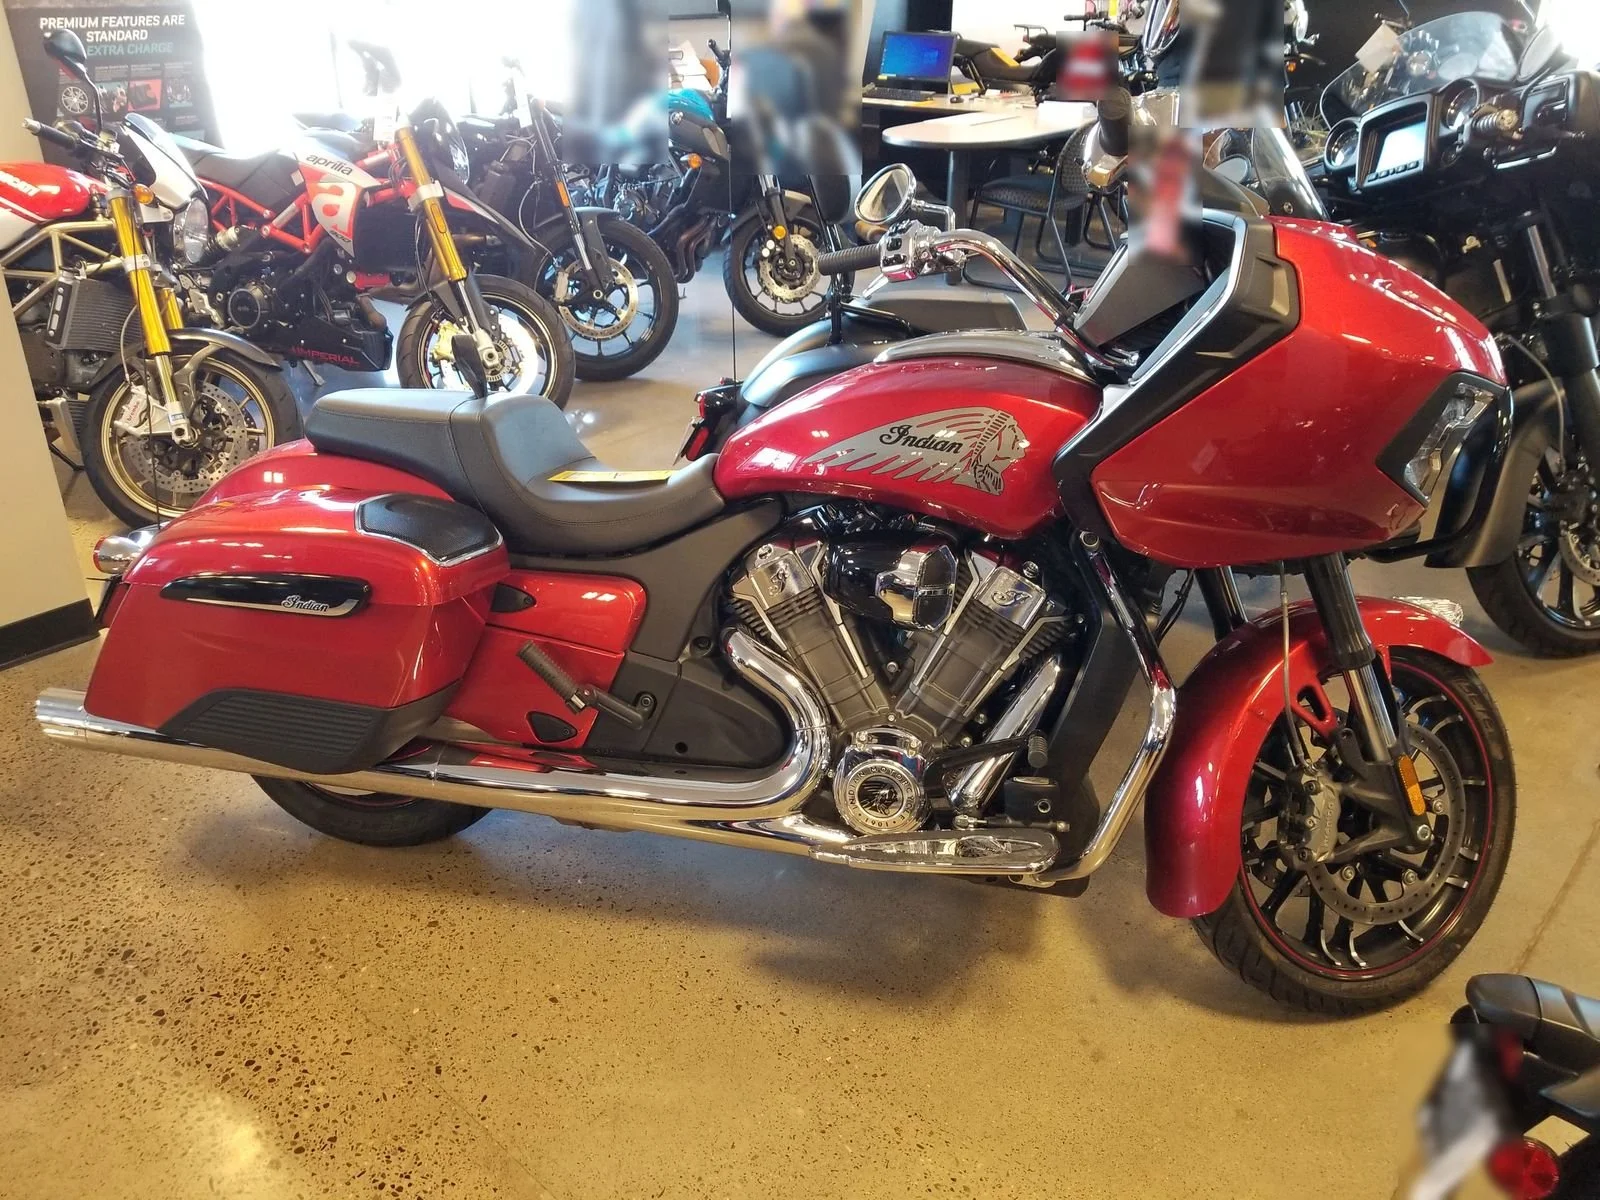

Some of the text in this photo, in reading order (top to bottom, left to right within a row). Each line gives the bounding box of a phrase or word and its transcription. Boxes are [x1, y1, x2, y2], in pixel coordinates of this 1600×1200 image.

[39, 14, 185, 29] PREMIUM FEATURES ARE
[86, 29, 148, 42] STANDARD
[87, 42, 174, 56] EXTRA CHARGE
[306, 154, 353, 176] aprilia
[879, 424, 963, 454] Indian
[281, 594, 330, 613] Indian
[847, 765, 915, 821] INDIAN MOTORCYCLE
